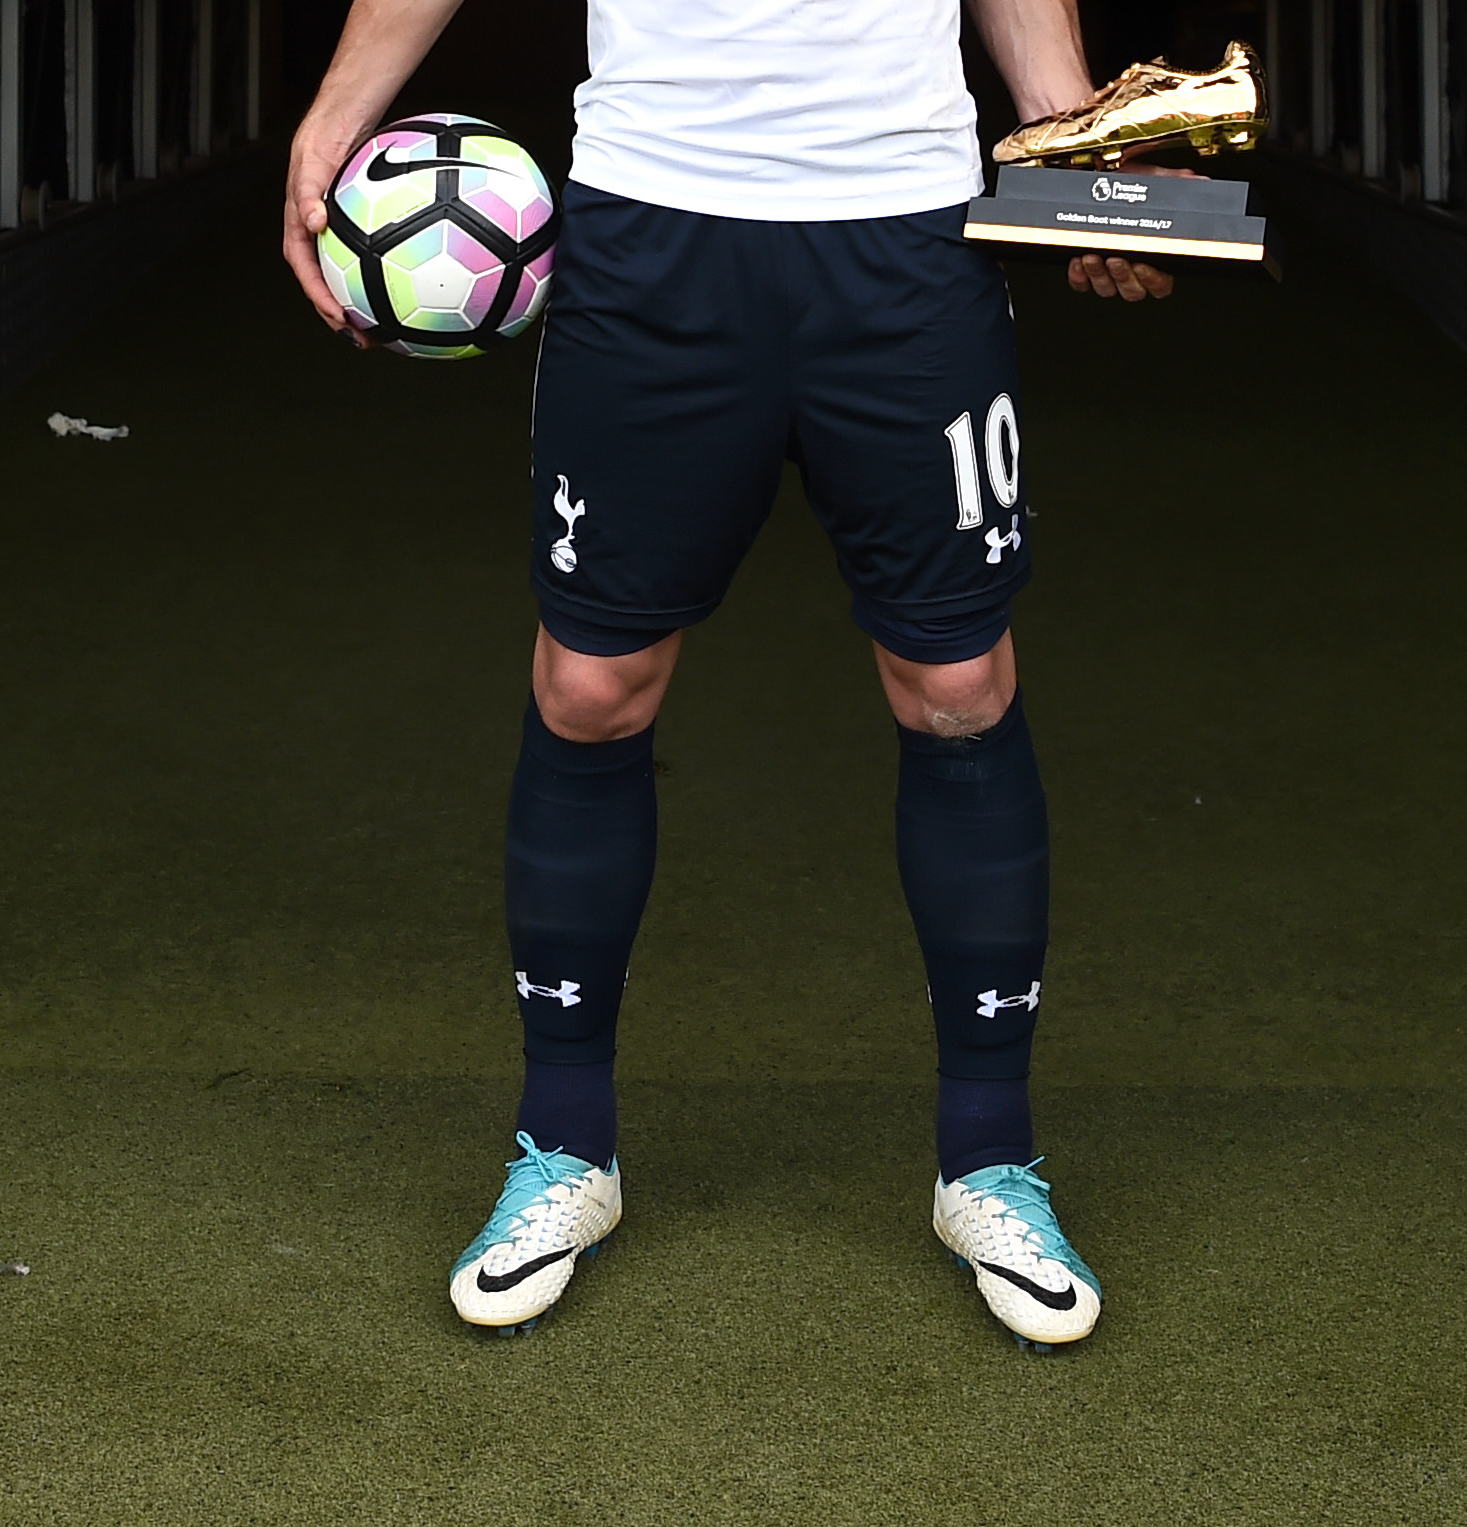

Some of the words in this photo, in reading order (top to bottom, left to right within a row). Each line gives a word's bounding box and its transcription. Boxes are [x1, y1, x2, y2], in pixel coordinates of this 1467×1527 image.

[1113, 181, 1148, 193] Premier
[1112, 192, 1147, 203] League
[1056, 212, 1087, 223] Golden
[1087, 214, 1109, 224] Boot
[944, 392, 1020, 531] 10
